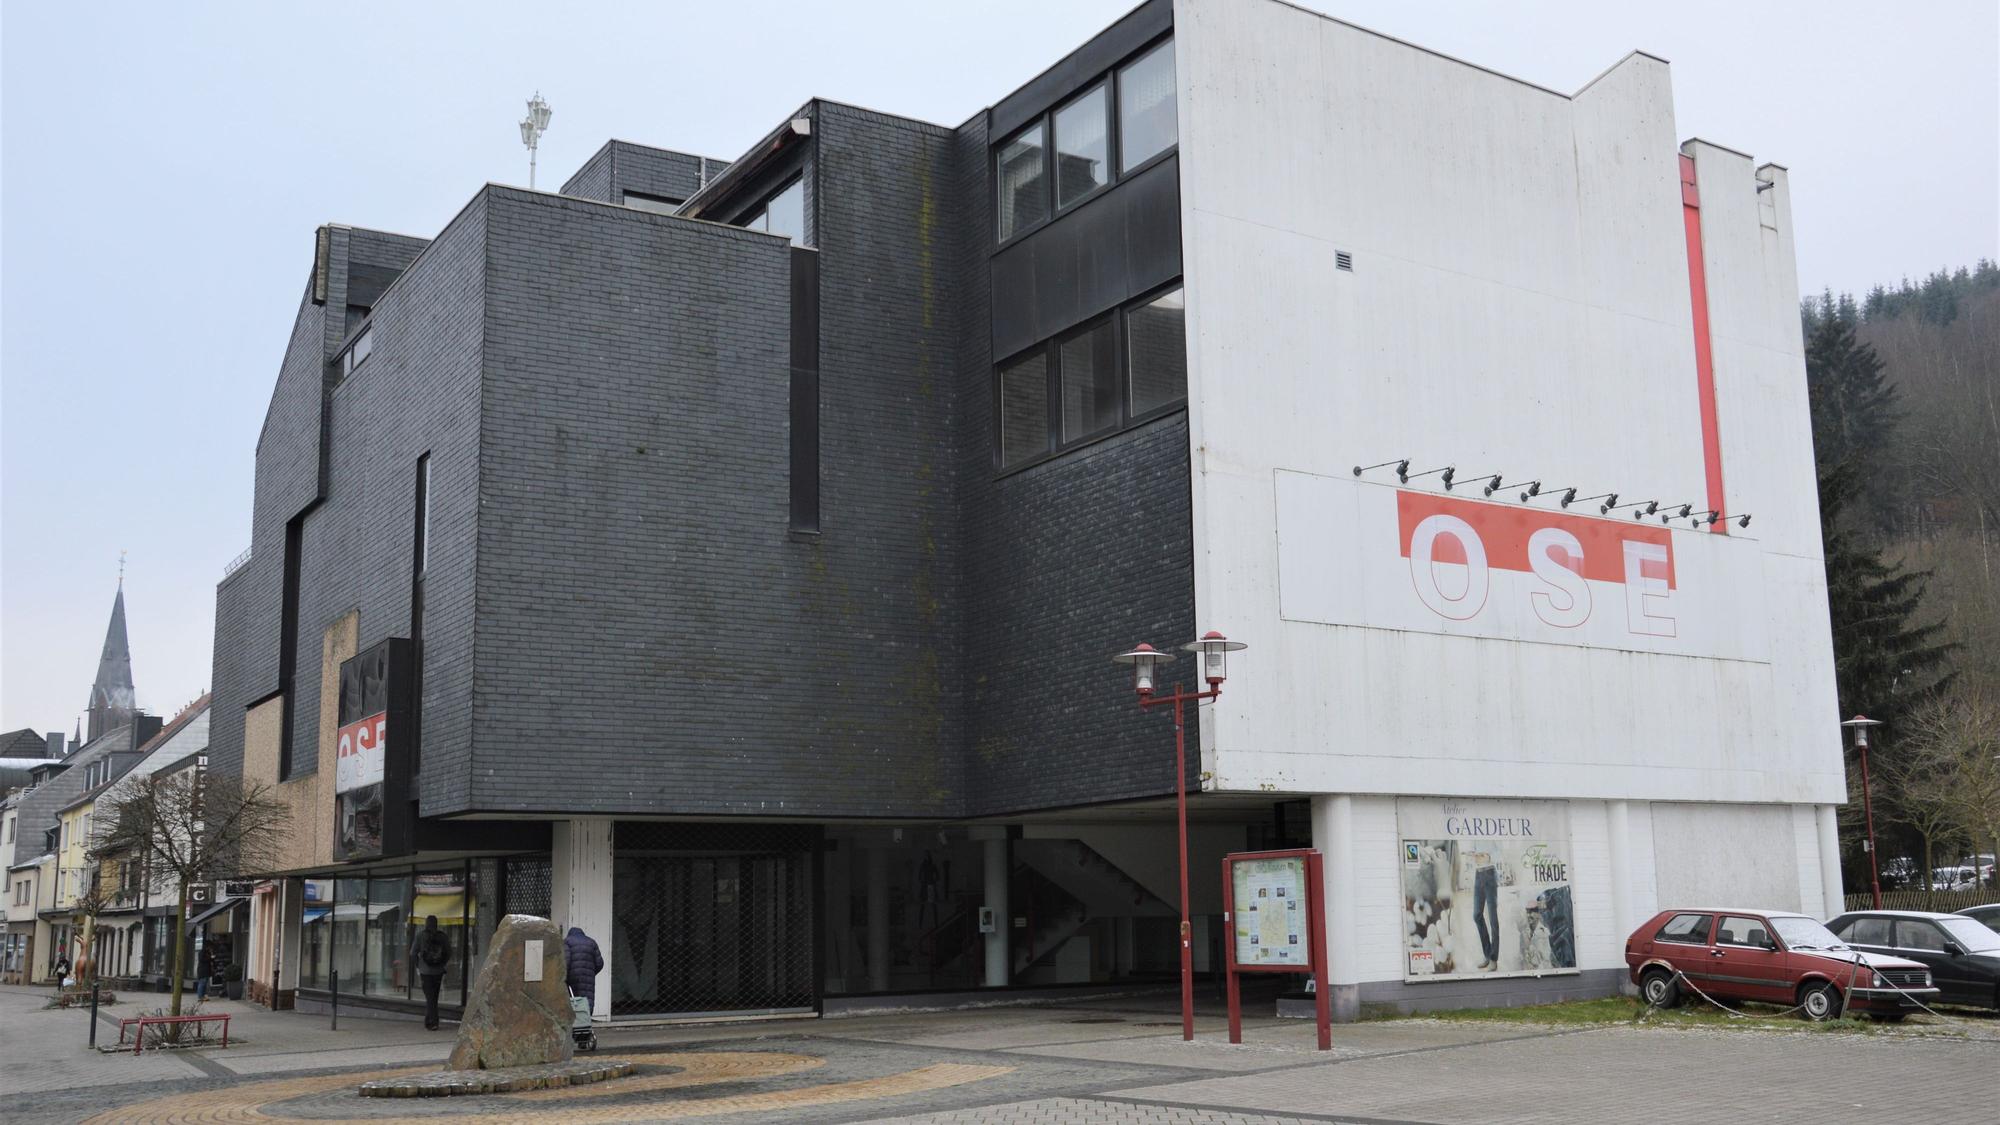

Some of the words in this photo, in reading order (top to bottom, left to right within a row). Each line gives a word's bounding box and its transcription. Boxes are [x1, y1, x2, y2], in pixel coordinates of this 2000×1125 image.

[1409, 514, 1677, 638] OSE
[338, 720, 386, 782] OSE
[1446, 816, 1534, 837] GARDEUR
[1533, 863, 1568, 882] TRADE
